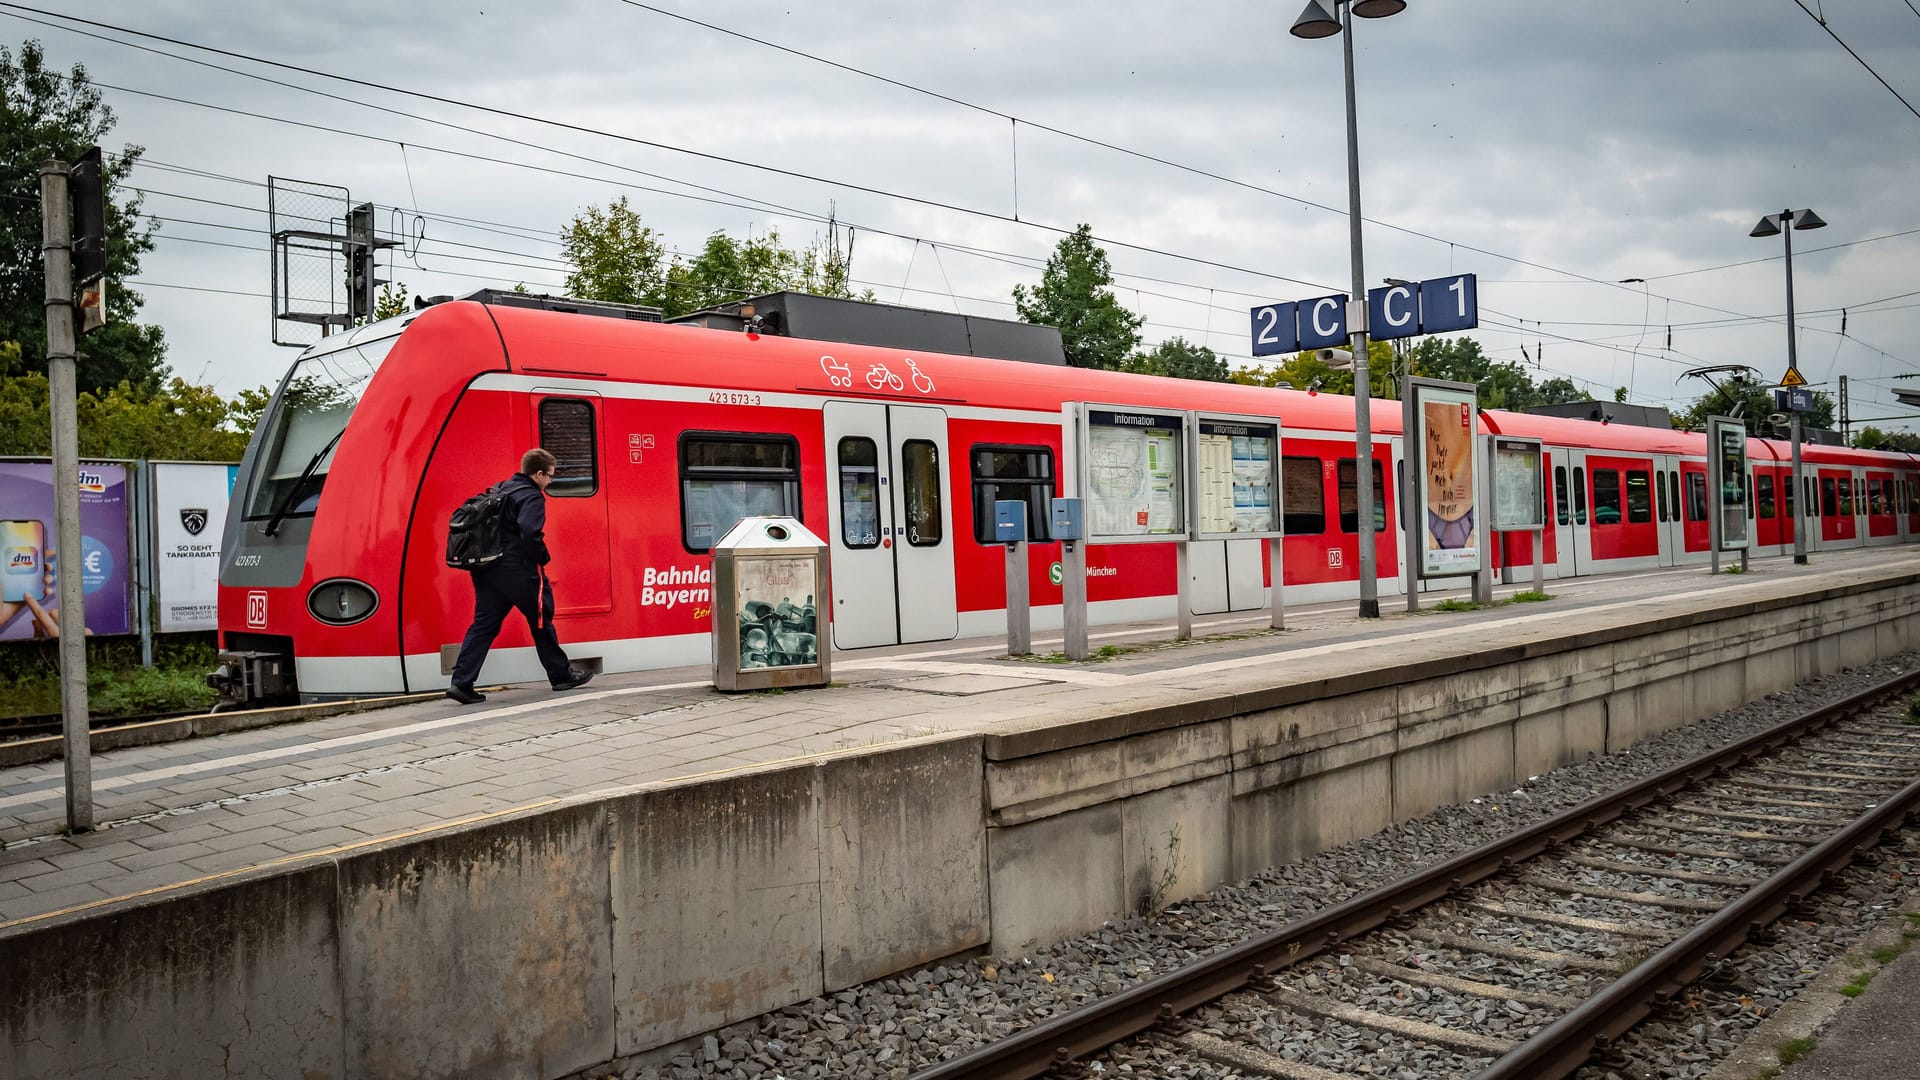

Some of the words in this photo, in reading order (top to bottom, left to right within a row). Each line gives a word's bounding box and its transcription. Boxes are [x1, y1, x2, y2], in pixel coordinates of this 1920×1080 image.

[1384, 287, 1412, 327] C
[1449, 277, 1466, 317] 1
[1257, 307, 1279, 345] 2
[1312, 298, 1339, 337] C
[709, 391, 728, 404] 423
[731, 393, 761, 406] 673-3
[1114, 413, 1155, 426] Information
[1213, 424, 1248, 436] Information
[13, 553, 31, 563] dm
[1330, 552, 1341, 565] DB
[766, 575, 790, 586] Glas
[1051, 564, 1063, 584] S
[1086, 566, 1117, 577] München
[641, 587, 709, 610] Bayern
[250, 597, 264, 622] DB
